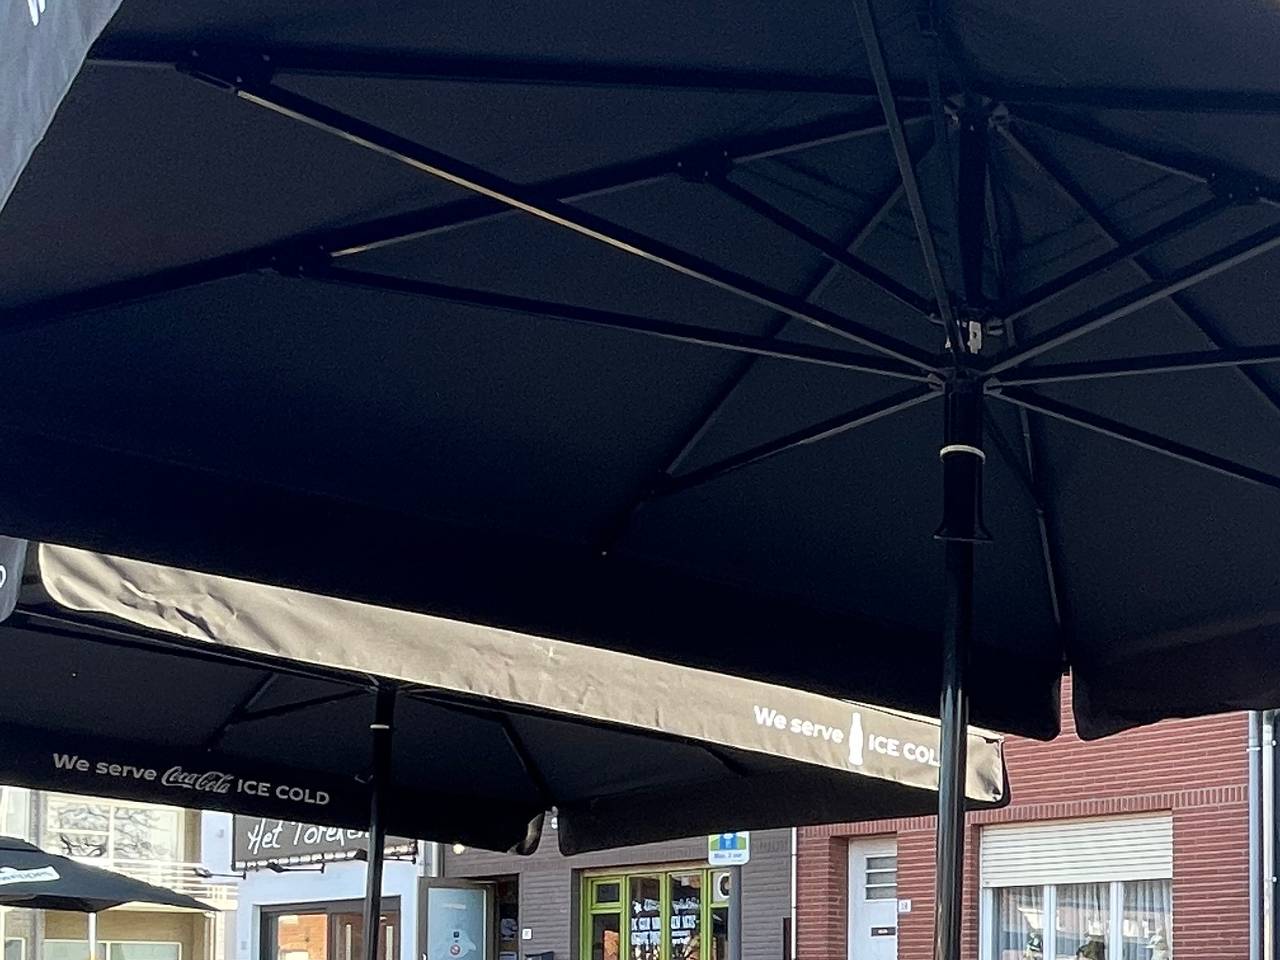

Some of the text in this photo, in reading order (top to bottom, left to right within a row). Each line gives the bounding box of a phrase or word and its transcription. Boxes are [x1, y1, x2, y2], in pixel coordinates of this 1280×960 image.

[753, 705, 941, 768] We serve ICE COL
[52, 752, 90, 772] We
[95, 761, 158, 781] serve
[237, 778, 271, 797] ICE
[275, 785, 330, 805] COLD
[247, 818, 370, 856] Het Toreke
